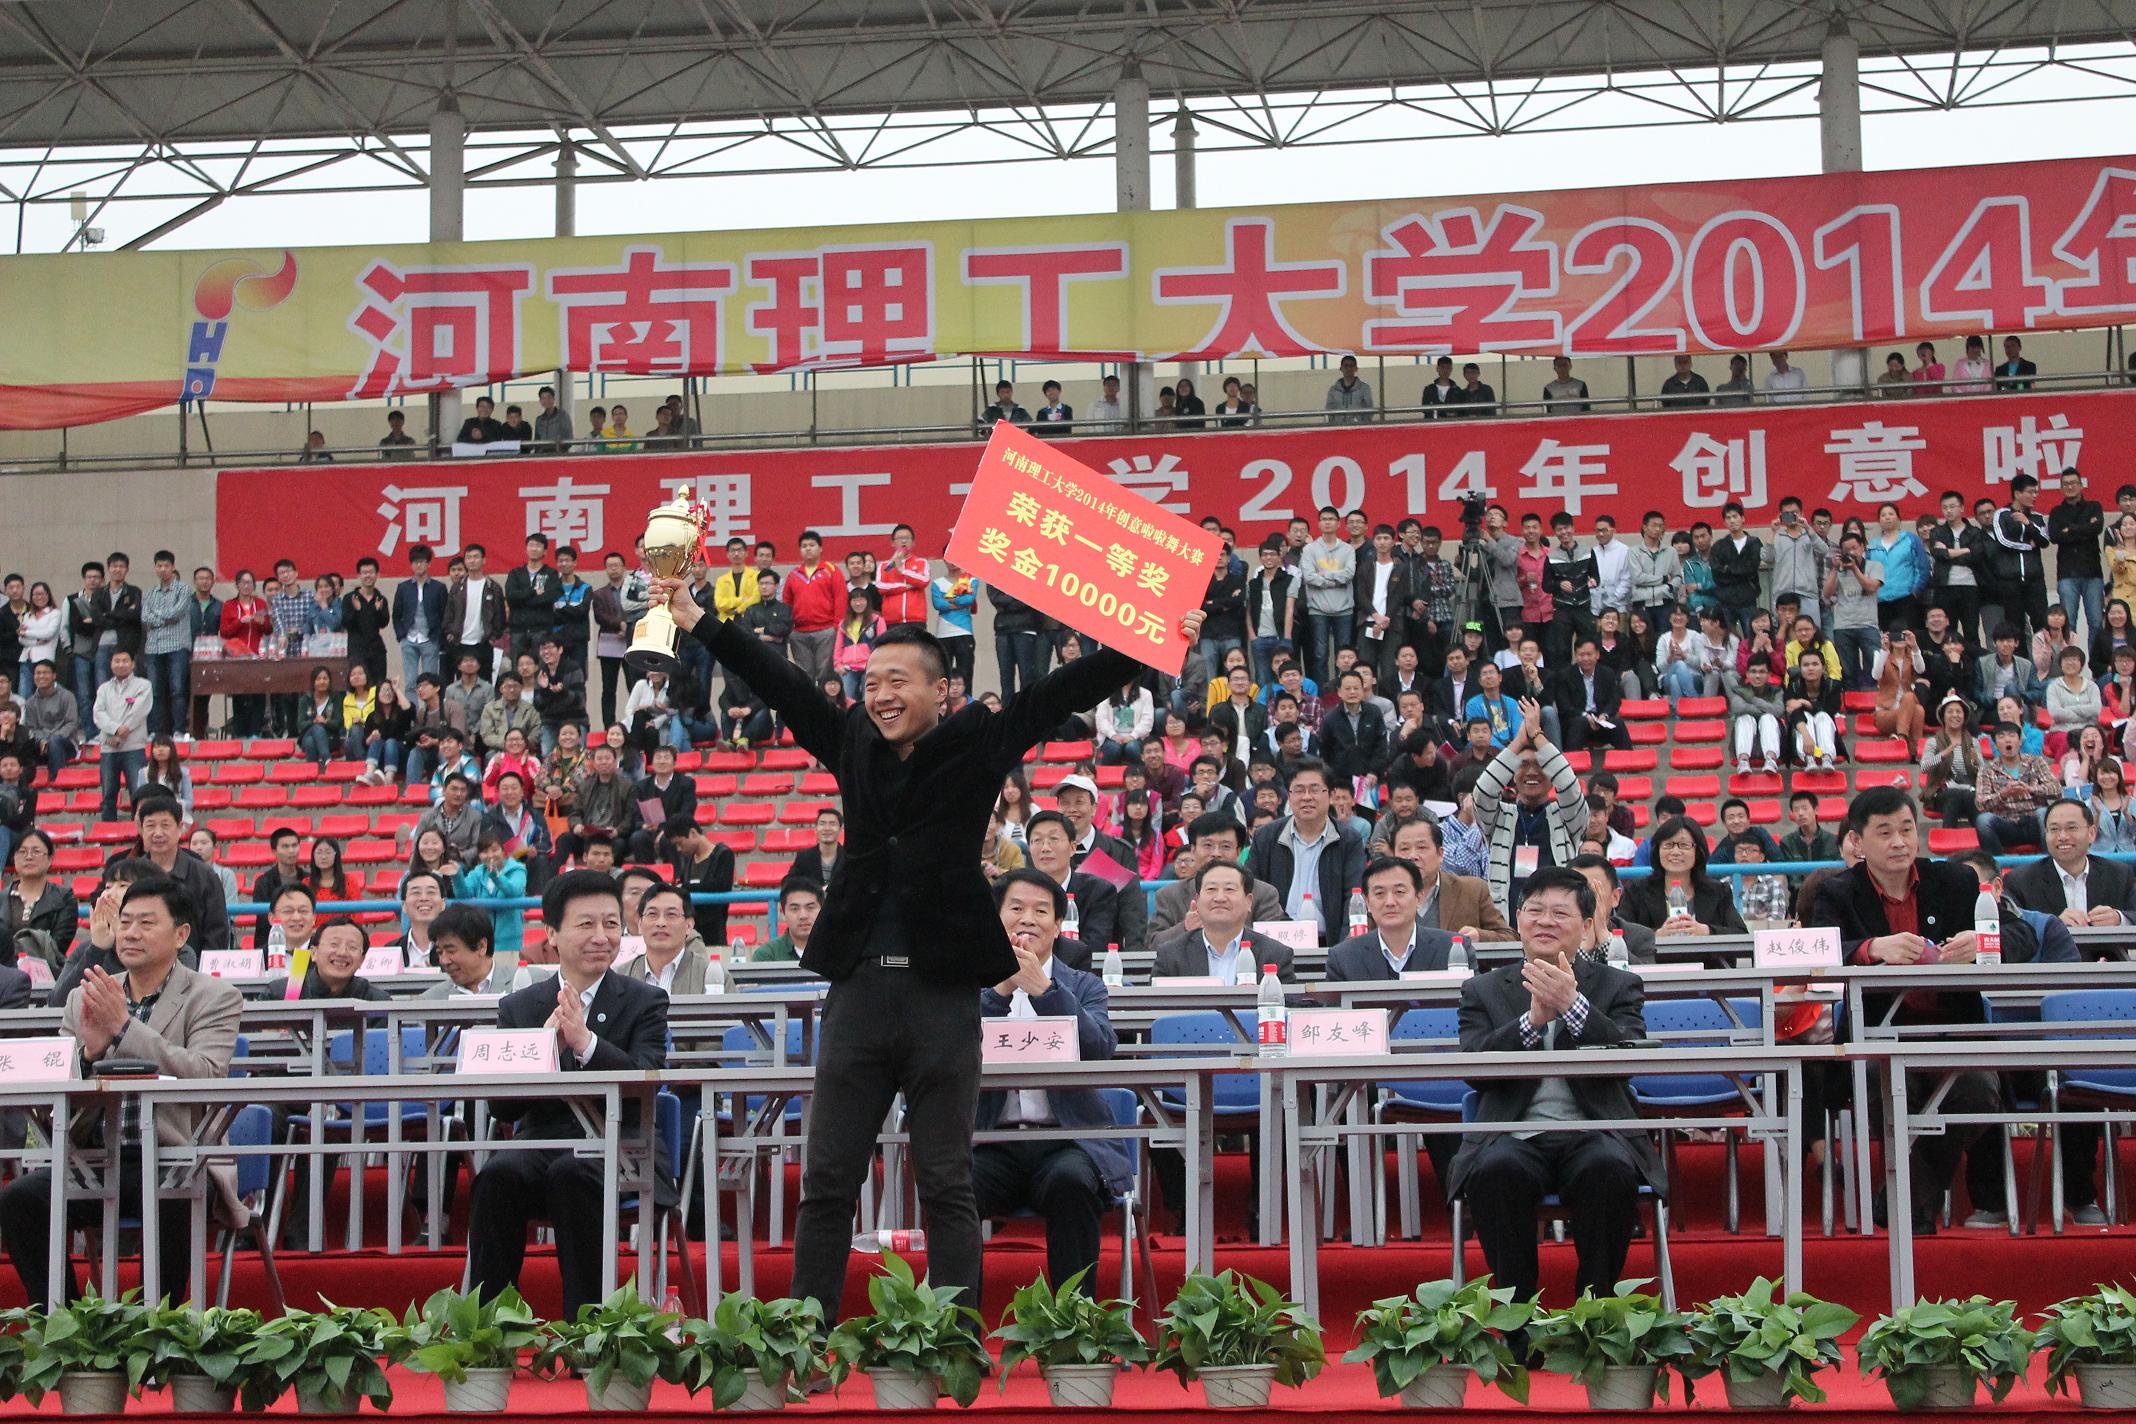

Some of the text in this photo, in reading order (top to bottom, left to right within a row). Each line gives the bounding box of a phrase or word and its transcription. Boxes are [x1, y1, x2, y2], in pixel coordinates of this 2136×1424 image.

[376, 412, 2089, 560] 河南理工学2014年创意啦
[1001, 446, 1205, 567] 河南理工大学2014年创意啦啦舞大赛
[1006, 490, 1171, 598] 荣获一等奖
[977, 527, 1167, 645] 奖金10000元
[1765, 937, 1831, 957] 赵俊伟
[471, 1040, 543, 1063] 周志远
[994, 1030, 1067, 1052] 王少安
[1300, 1021, 1376, 1046] 邹友峰
